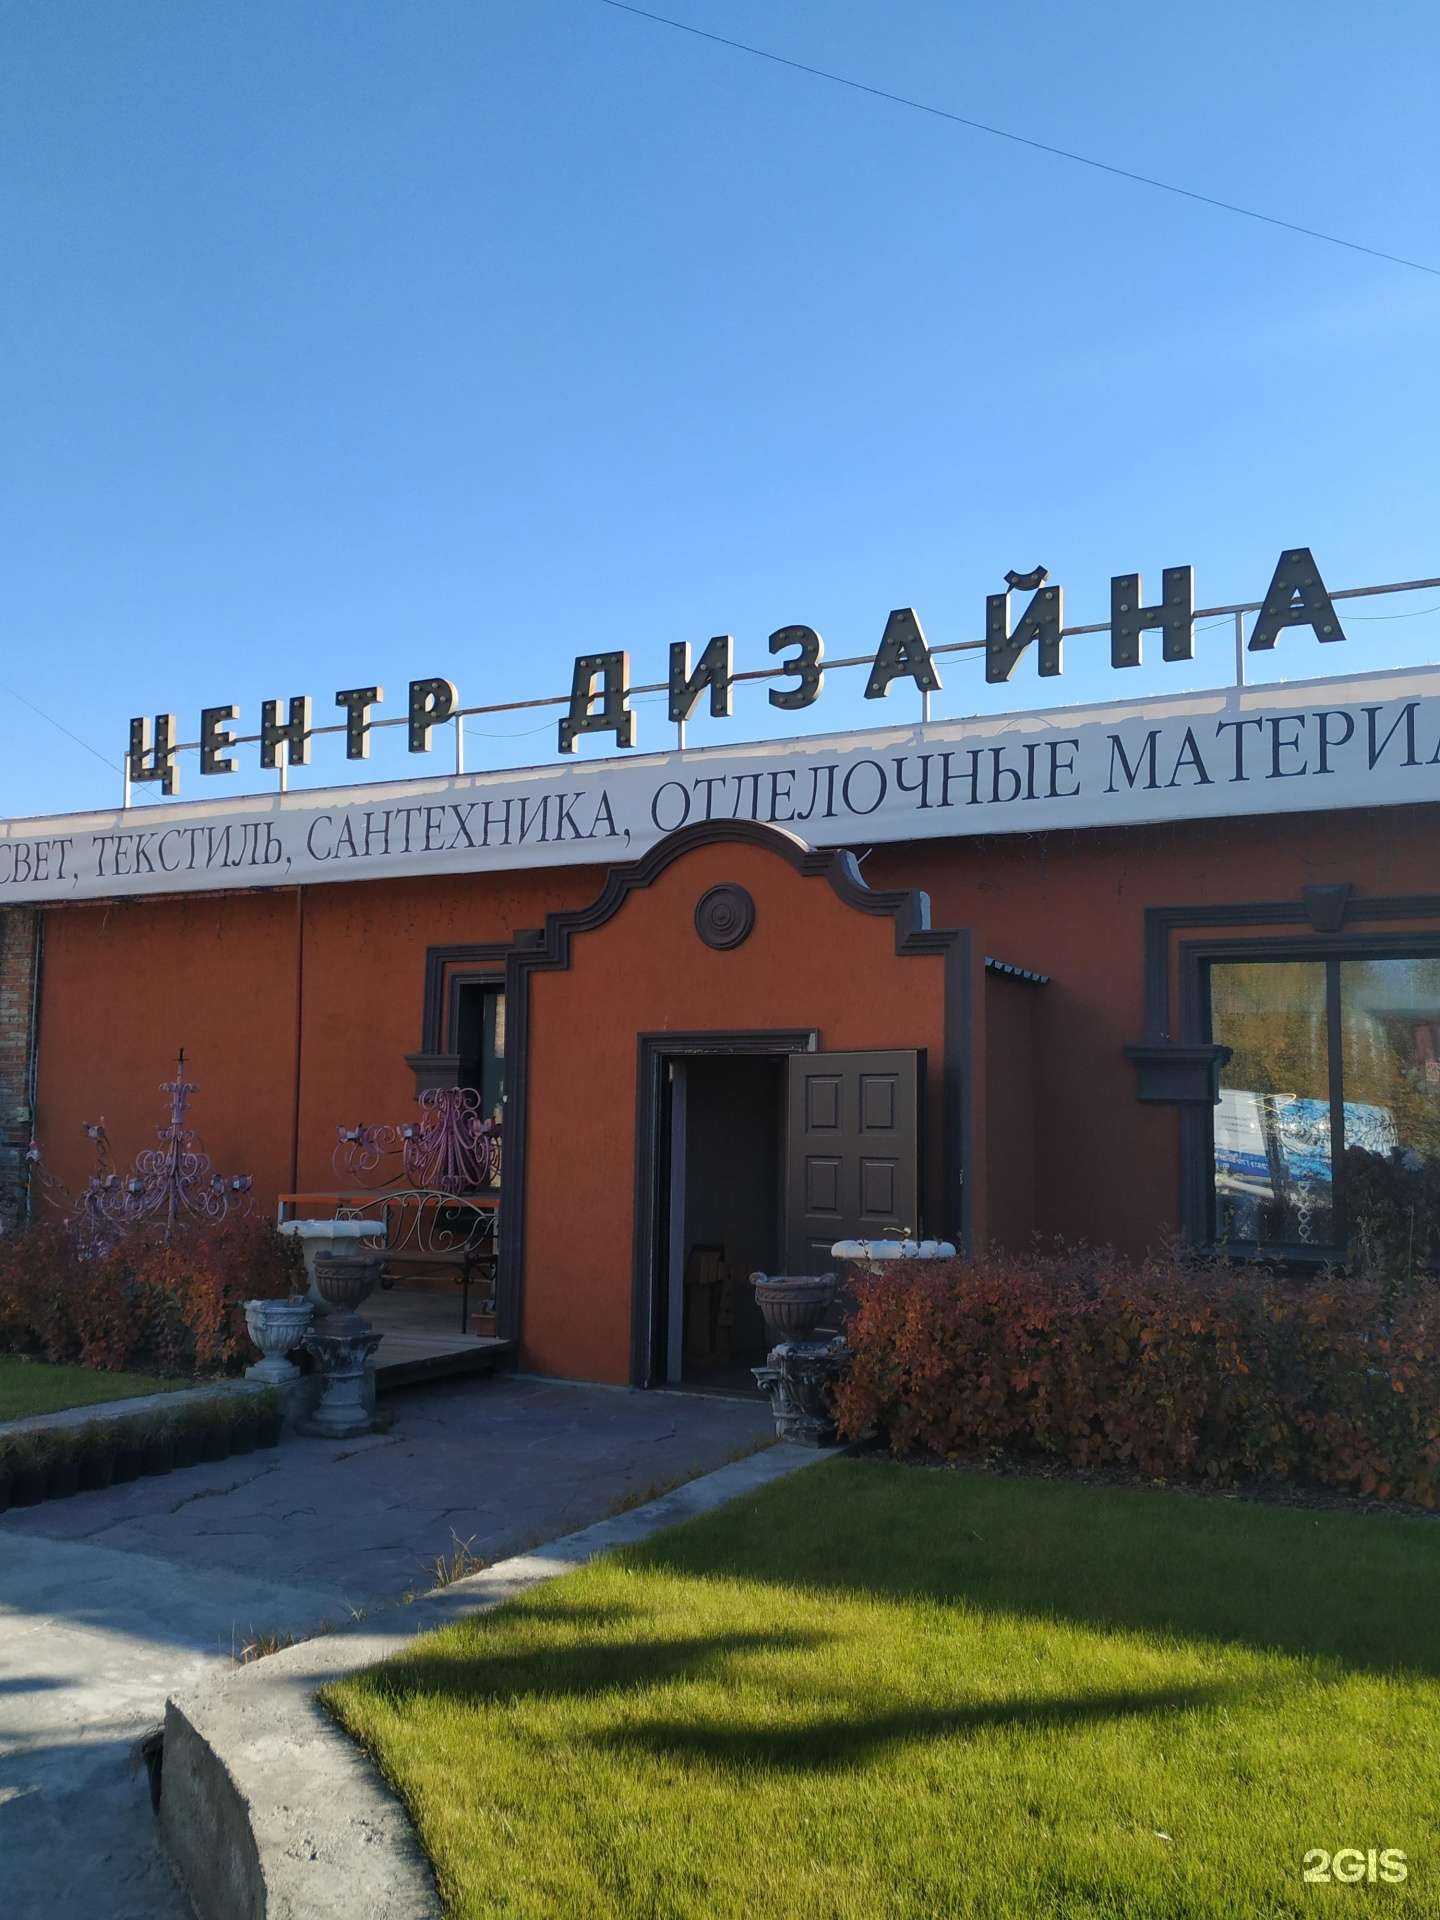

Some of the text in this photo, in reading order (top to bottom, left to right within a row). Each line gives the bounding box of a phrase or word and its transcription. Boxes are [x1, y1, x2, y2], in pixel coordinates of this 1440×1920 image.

[128, 547, 1347, 795] ЦЕНТР ДИЗАЙНА
[91, 821, 292, 875] ТЕКСТИЛЬ,
[306, 789, 631, 861] САНТЕХНИКА,
[1104, 702, 1440, 793] МАТЕРИ
